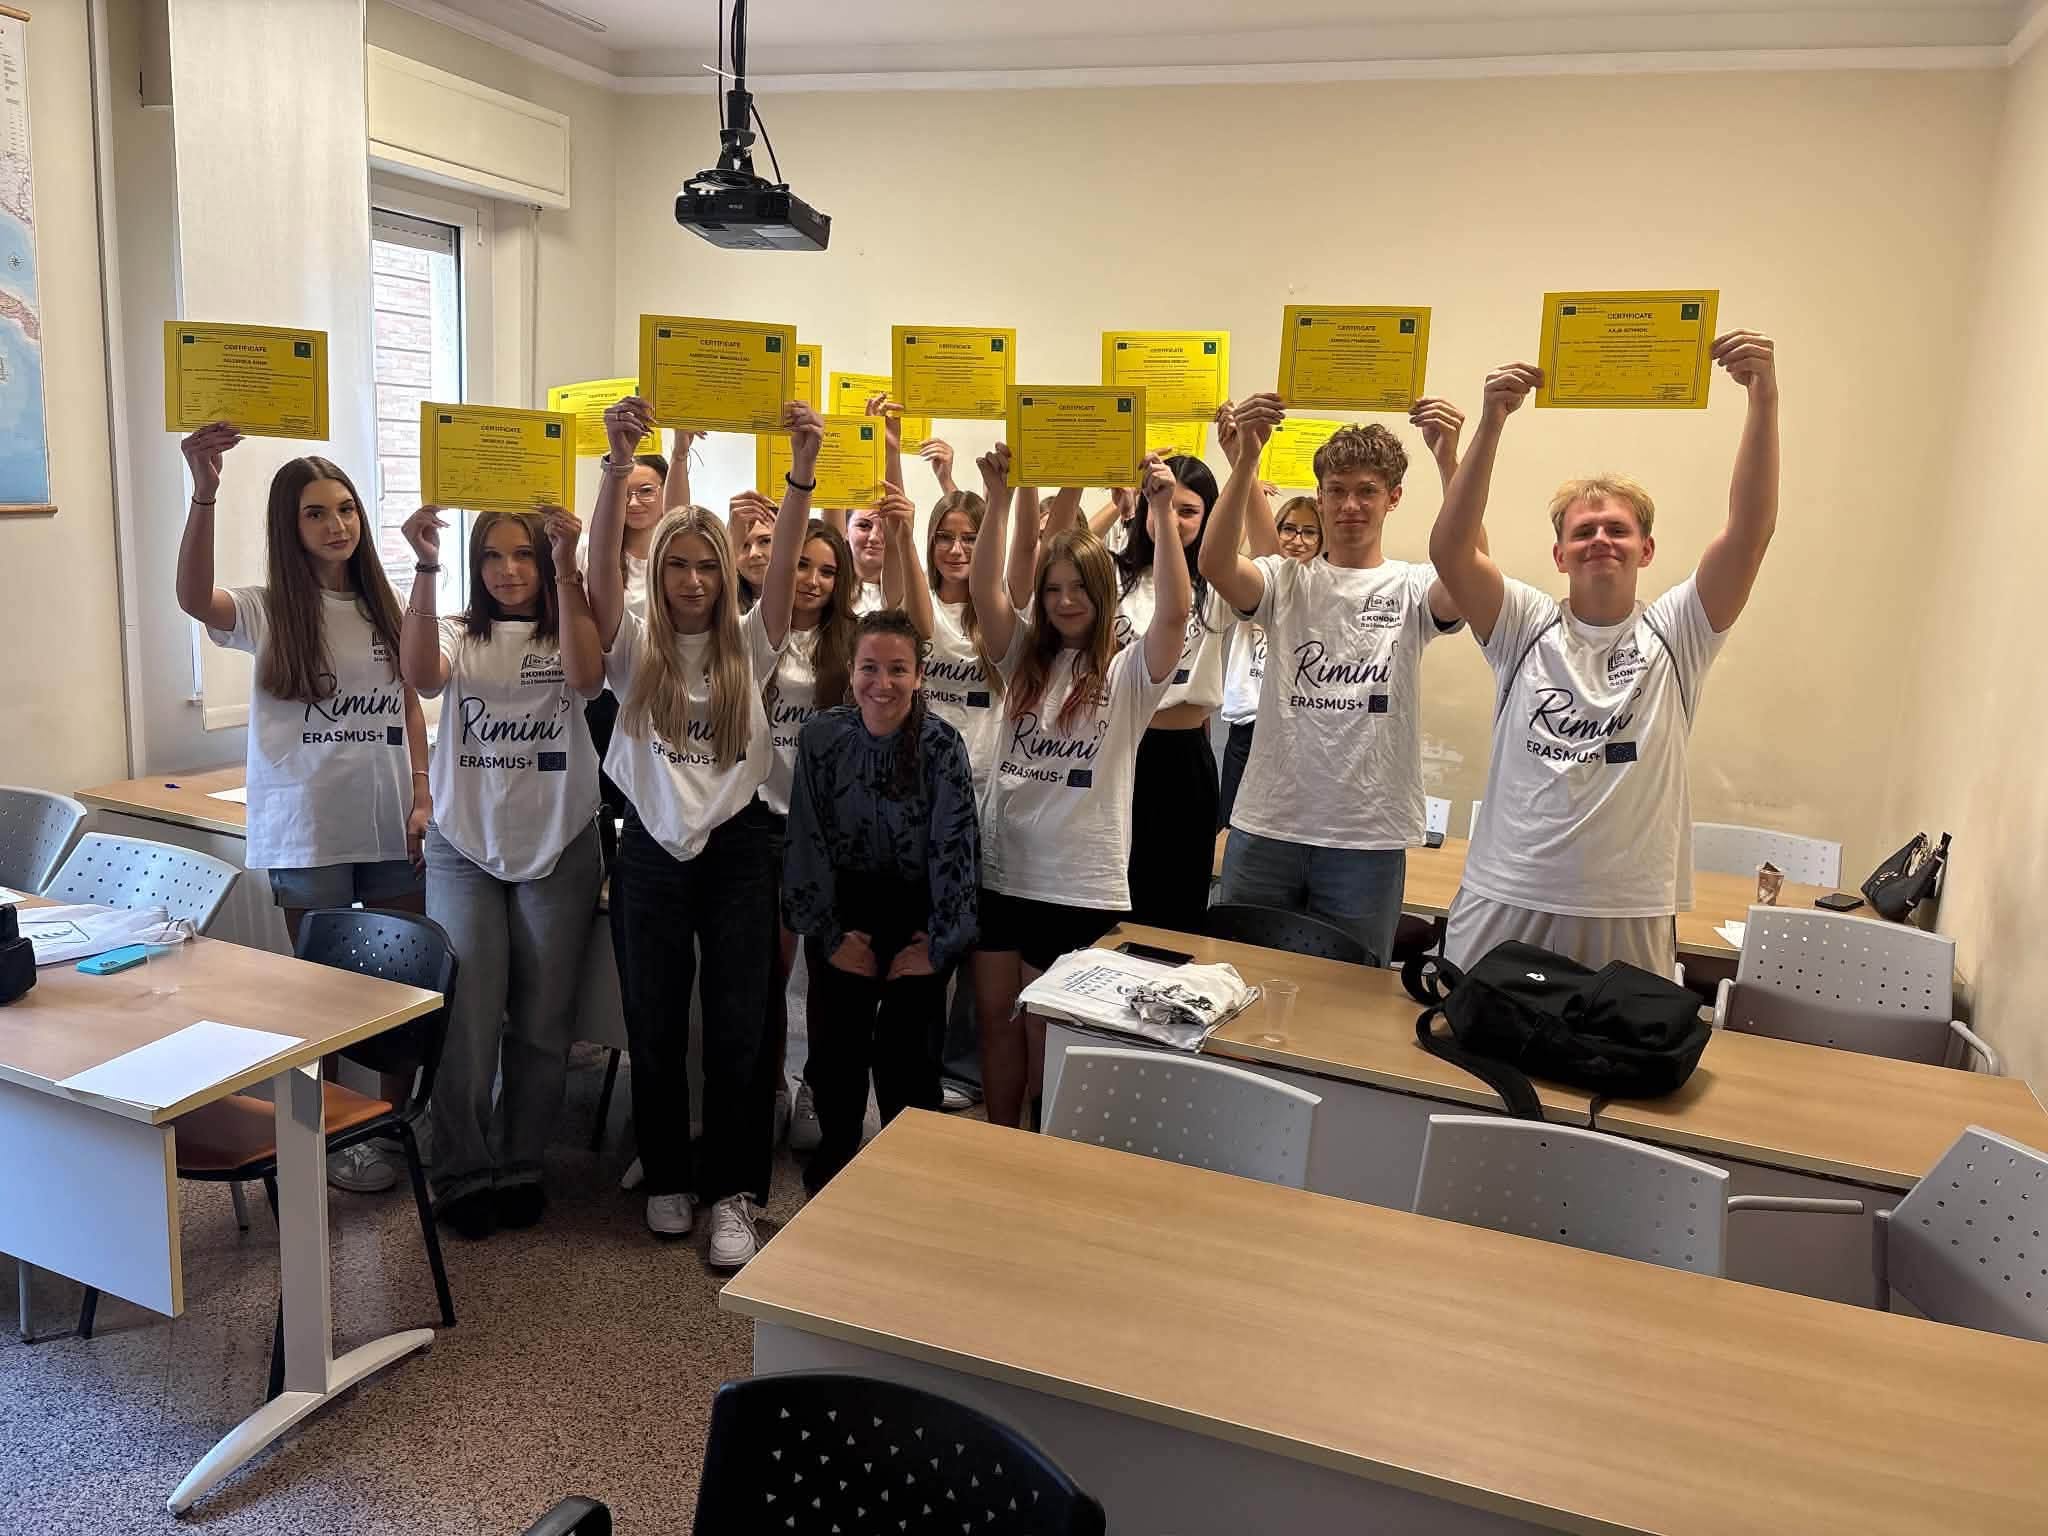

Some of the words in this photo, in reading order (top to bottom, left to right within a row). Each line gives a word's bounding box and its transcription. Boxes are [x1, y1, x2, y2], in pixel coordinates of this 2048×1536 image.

[1607, 312, 1653, 320] CERTIFICATE
[1293, 640, 1392, 689] Rimini
[1290, 695, 1364, 710] ERASMUS+
[459, 696, 564, 748] Rimini
[302, 730, 385, 745] ERASMUS+
[1011, 711, 1101, 760] Rimini
[459, 754, 533, 769] ERASMUS+
[652, 741, 719, 765] ERSMUS+
[1000, 760, 1064, 783] ERASMUS+
